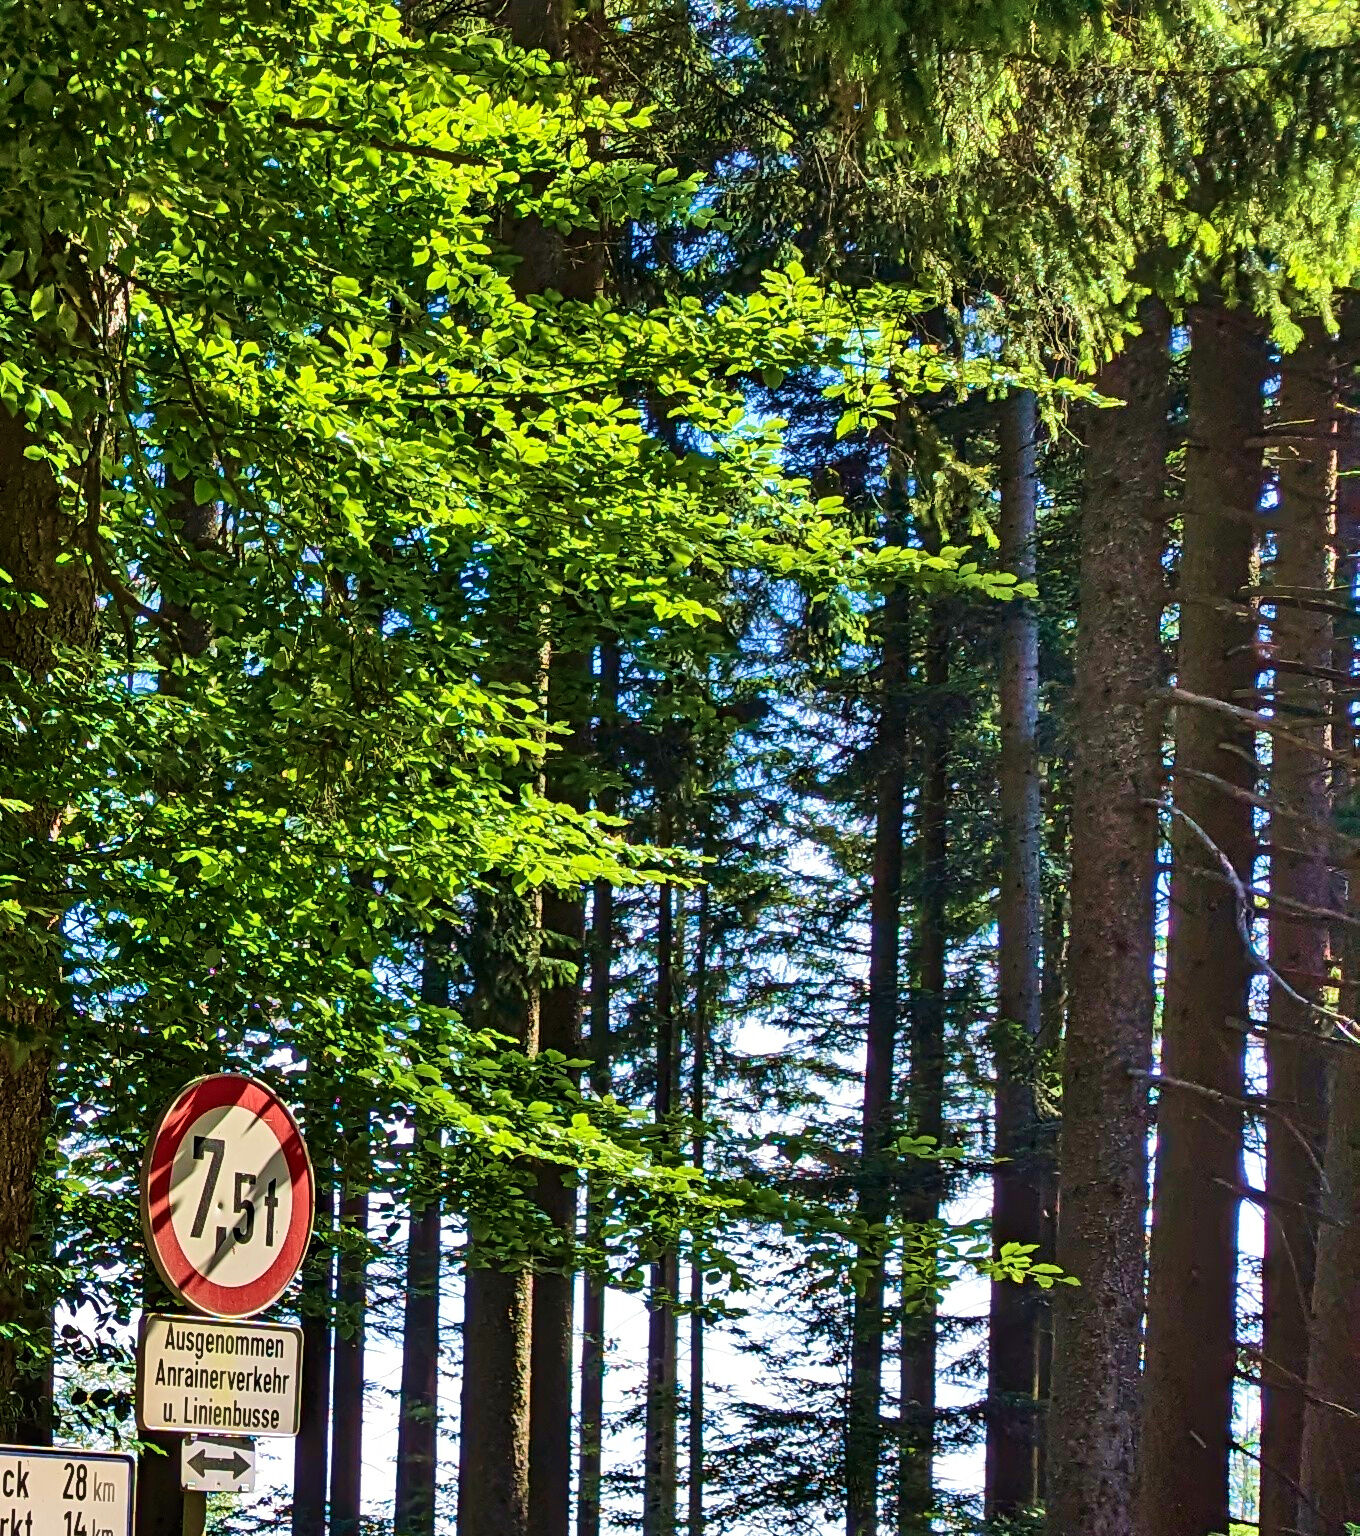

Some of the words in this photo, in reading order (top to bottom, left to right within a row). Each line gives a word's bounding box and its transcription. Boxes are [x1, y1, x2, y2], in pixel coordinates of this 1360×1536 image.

[164, 1322, 284, 1360] Ausgenommen
[154, 1358, 290, 1394] Anrainerverkehr
[163, 1402, 177, 1424] u.
[183, 1397, 280, 1429] Linienbusse
[62, 1462, 88, 1501] 28
[93, 1472, 116, 1502] km
